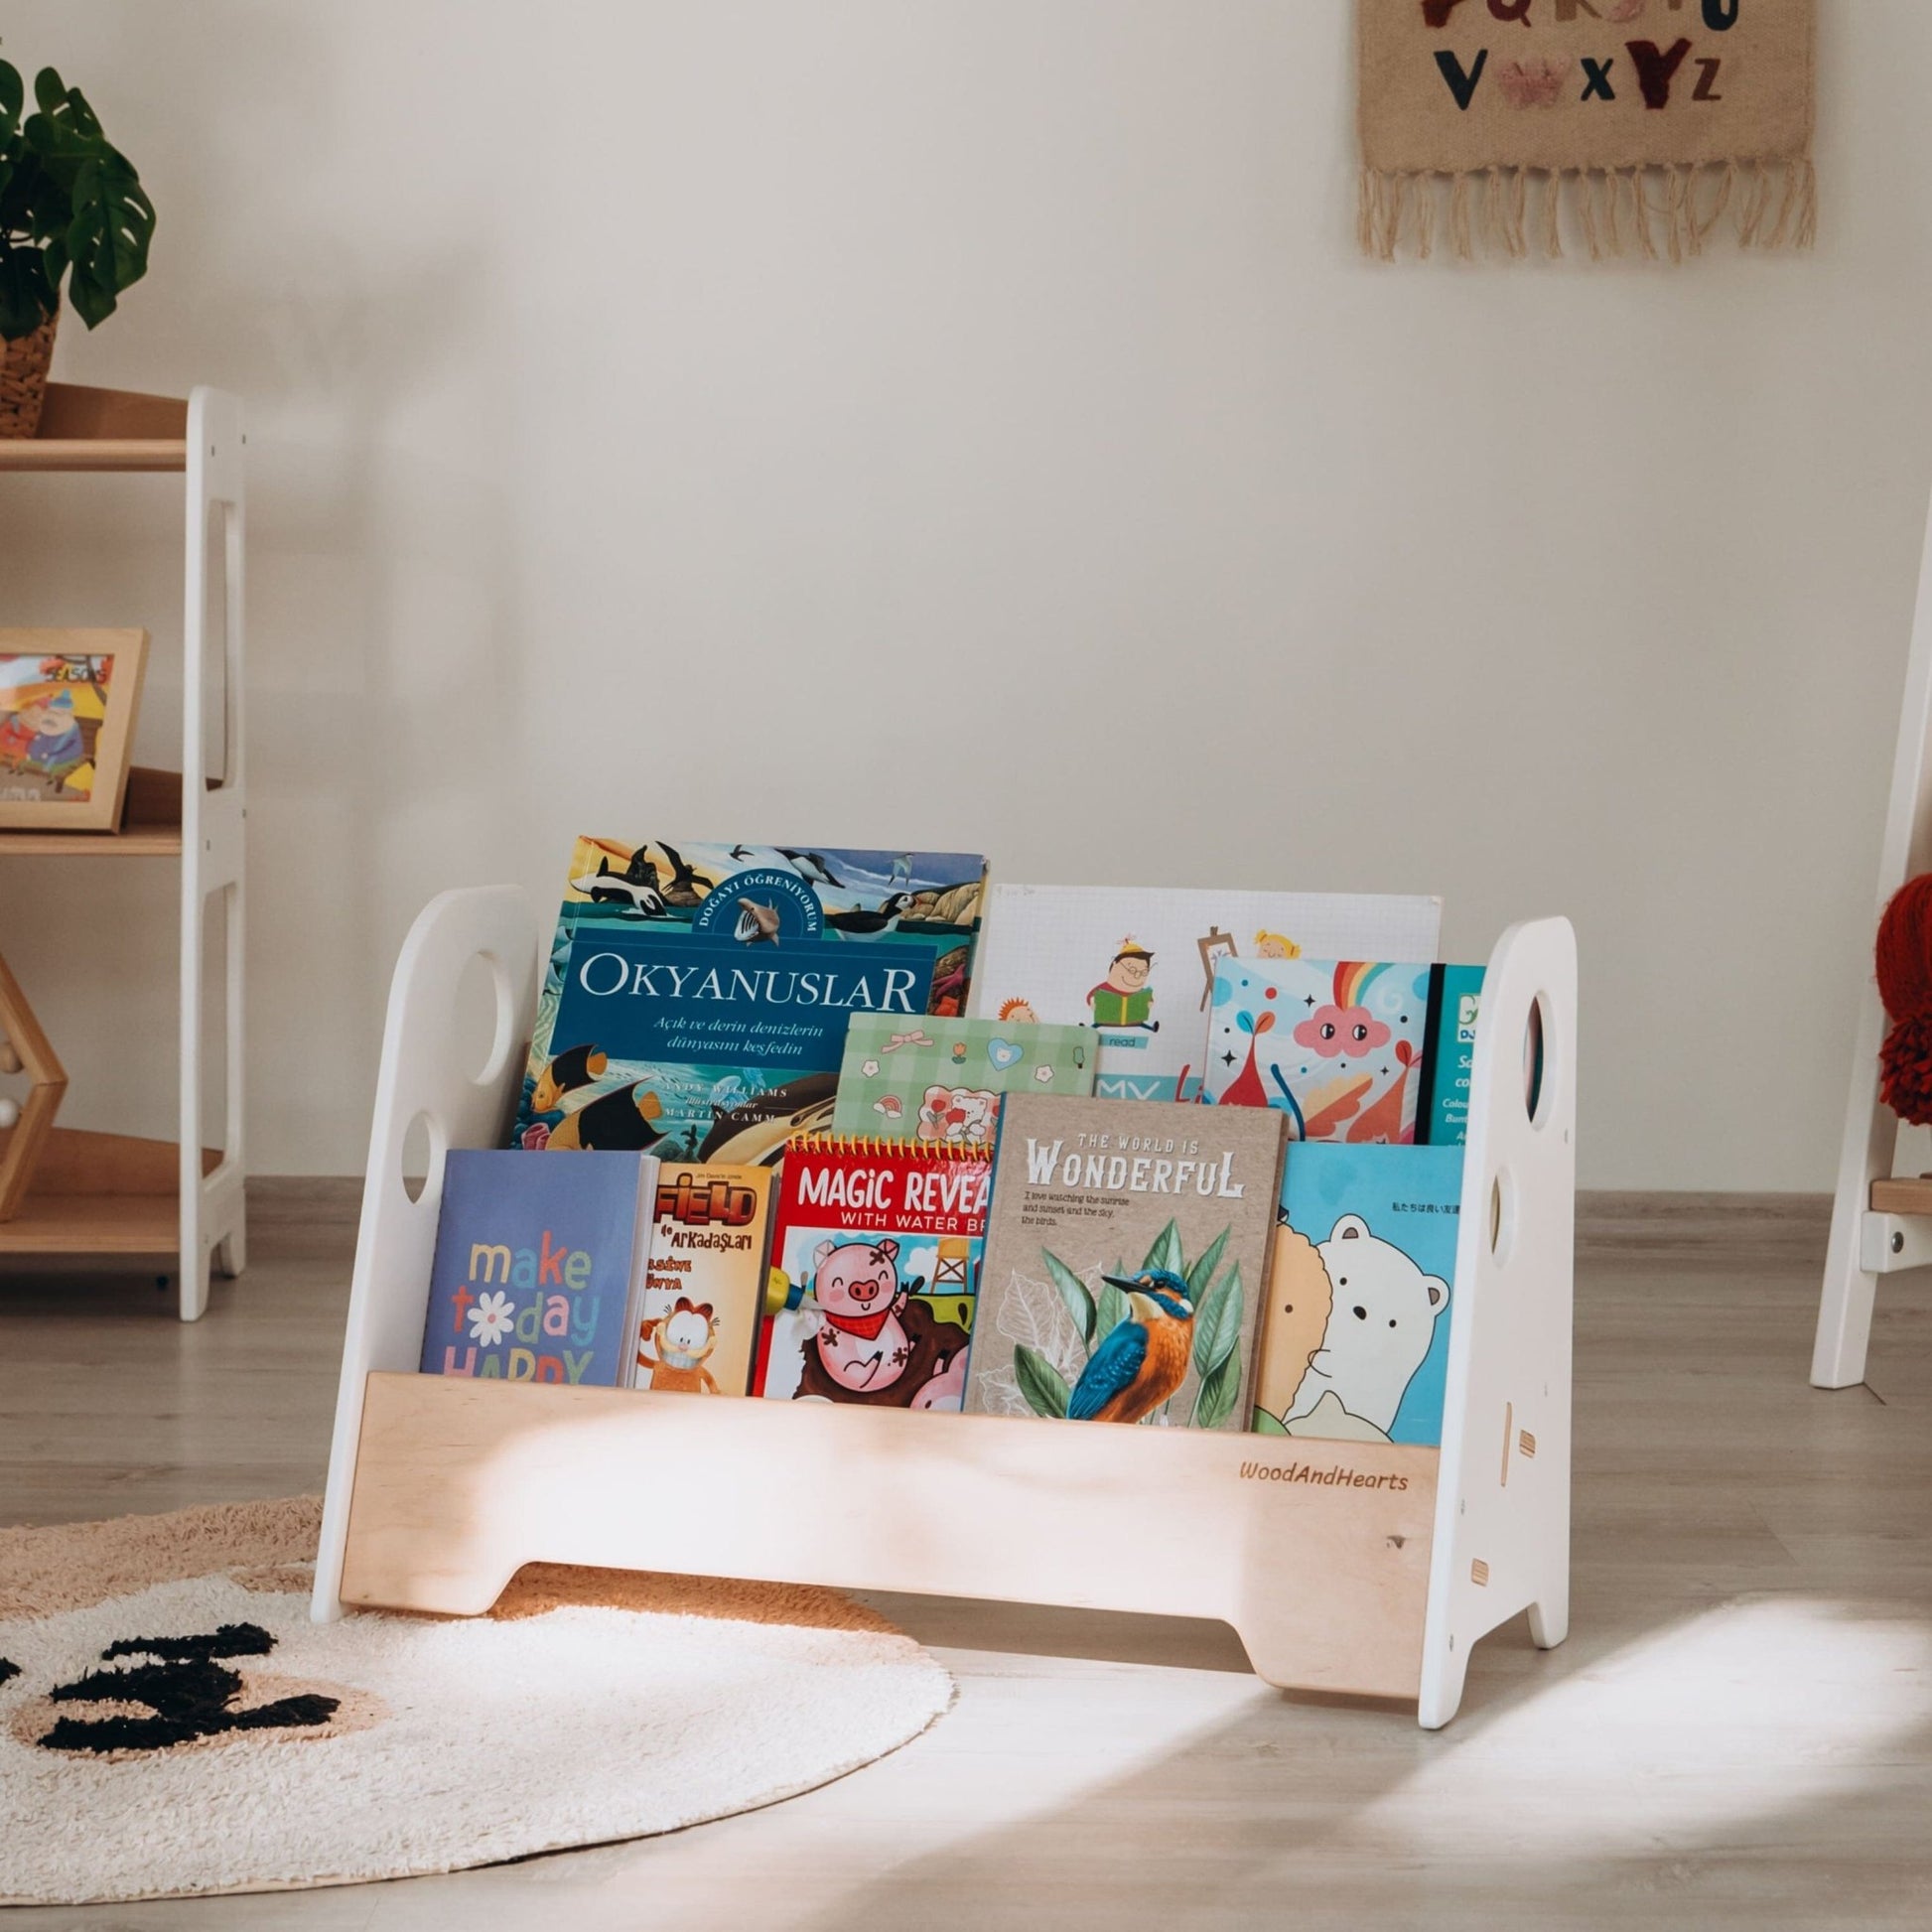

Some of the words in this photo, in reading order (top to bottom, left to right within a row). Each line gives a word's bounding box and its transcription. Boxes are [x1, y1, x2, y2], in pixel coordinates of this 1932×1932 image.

[579, 952, 916, 1013] OKYANUSLAR
[652, 1017, 687, 1031] Açık
[689, 1020, 706, 1031] ve
[708, 1019, 747, 1034] derin
[750, 1022, 824, 1037] denizlerin
[666, 1035, 740, 1052] dünyasını
[743, 1039, 803, 1056] keşfedin
[1108, 1037, 1137, 1047] read
[713, 1083, 788, 1098] WILLIAMS
[665, 1108, 724, 1120] MARTIN
[731, 1111, 775, 1123] CAMM
[1078, 1133, 1110, 1149] THE
[1119, 1136, 1175, 1154] WORLD
[1181, 1140, 1199, 1156] IS
[1027, 1138, 1246, 1199] WONDERFUL
[1032, 1191, 1047, 1200] love
[1048, 1193, 1085, 1204] watching
[1086, 1195, 1100, 1205] the
[1101, 1197, 1130, 1206] sunrise
[1038, 1204, 1065, 1214] sunset
[841, 1212, 888, 1227] WITH
[896, 1214, 958, 1231] WATER
[1021, 1216, 1035, 1225] the
[469, 1230, 593, 1291] make
[1239, 1461, 1410, 1491] WoodAndHearts
